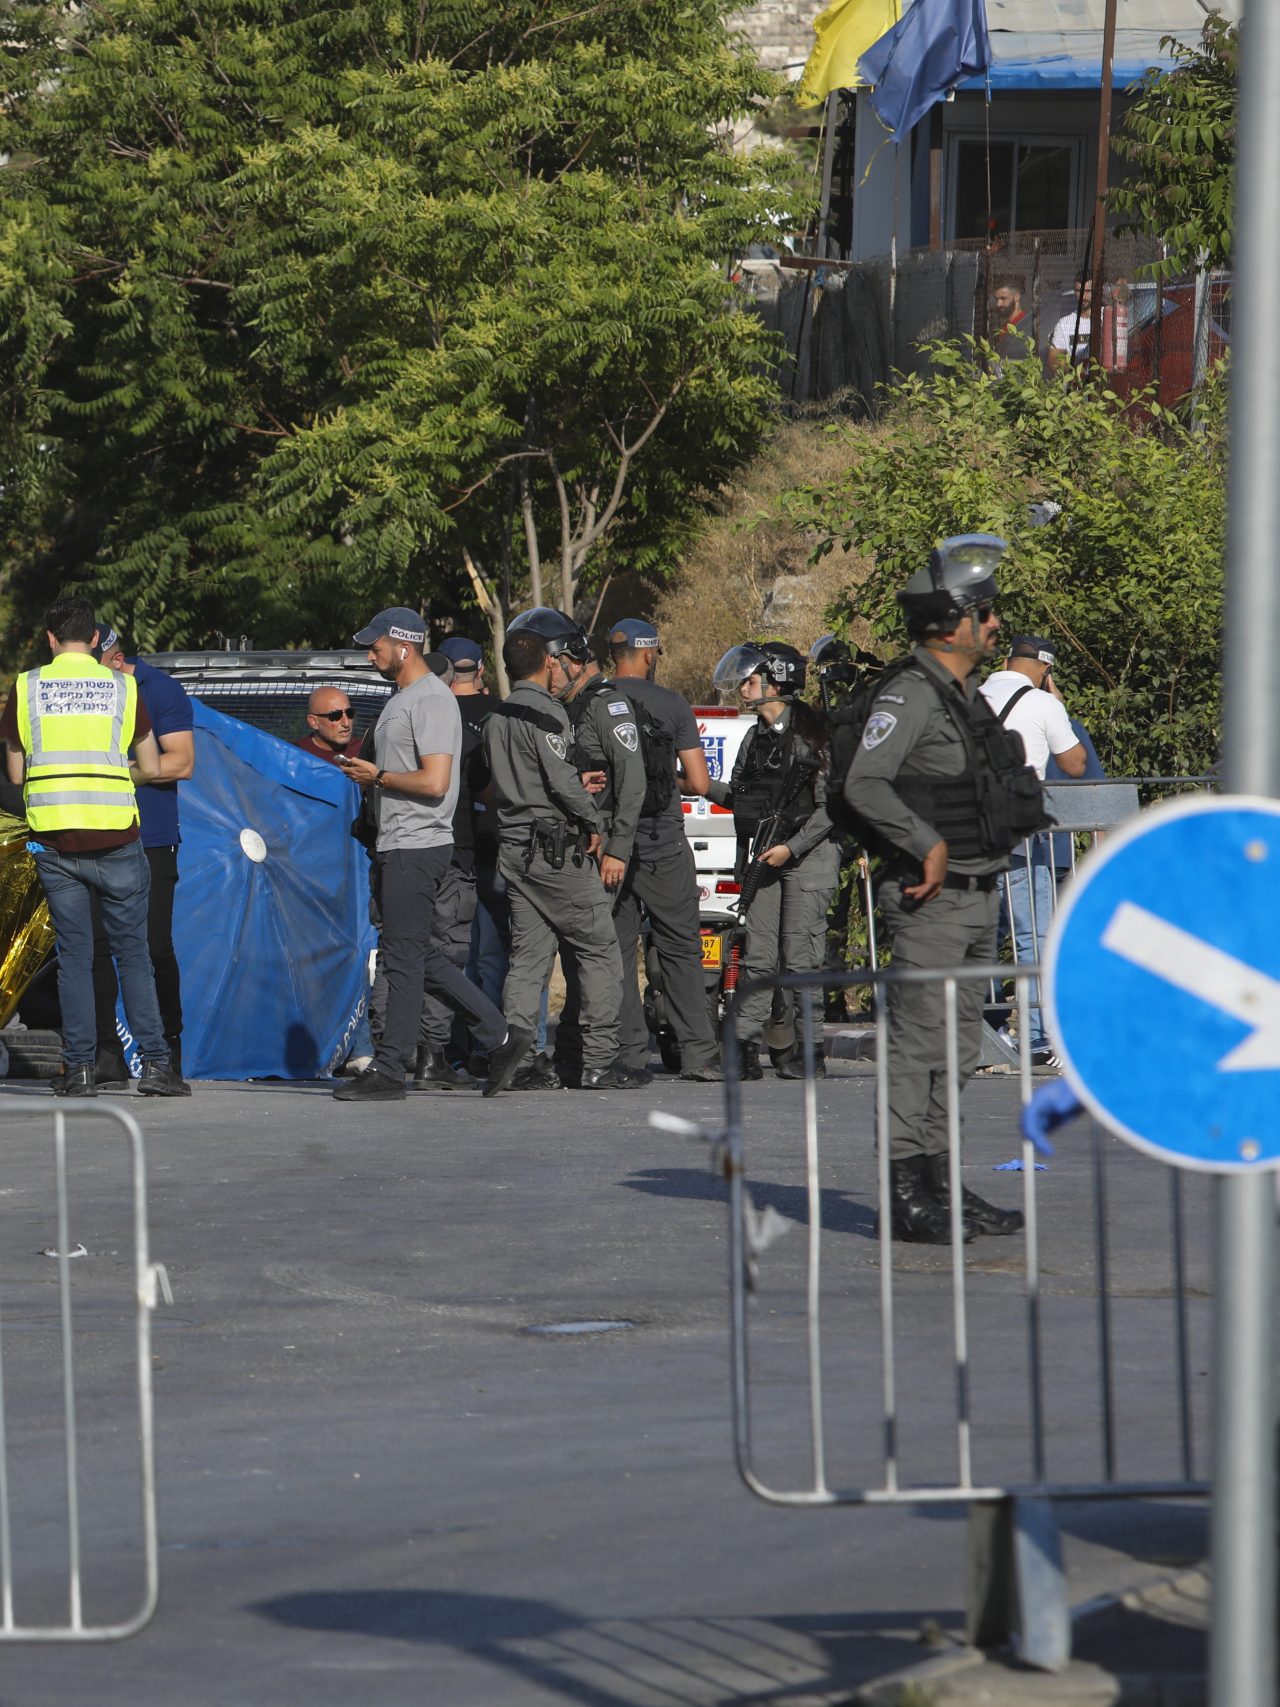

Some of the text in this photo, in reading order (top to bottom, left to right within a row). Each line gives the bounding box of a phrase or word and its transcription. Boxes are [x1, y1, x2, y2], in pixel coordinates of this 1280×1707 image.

[391, 629, 423, 641] POLICE
[40, 680, 114, 689] משטרת ישראל
